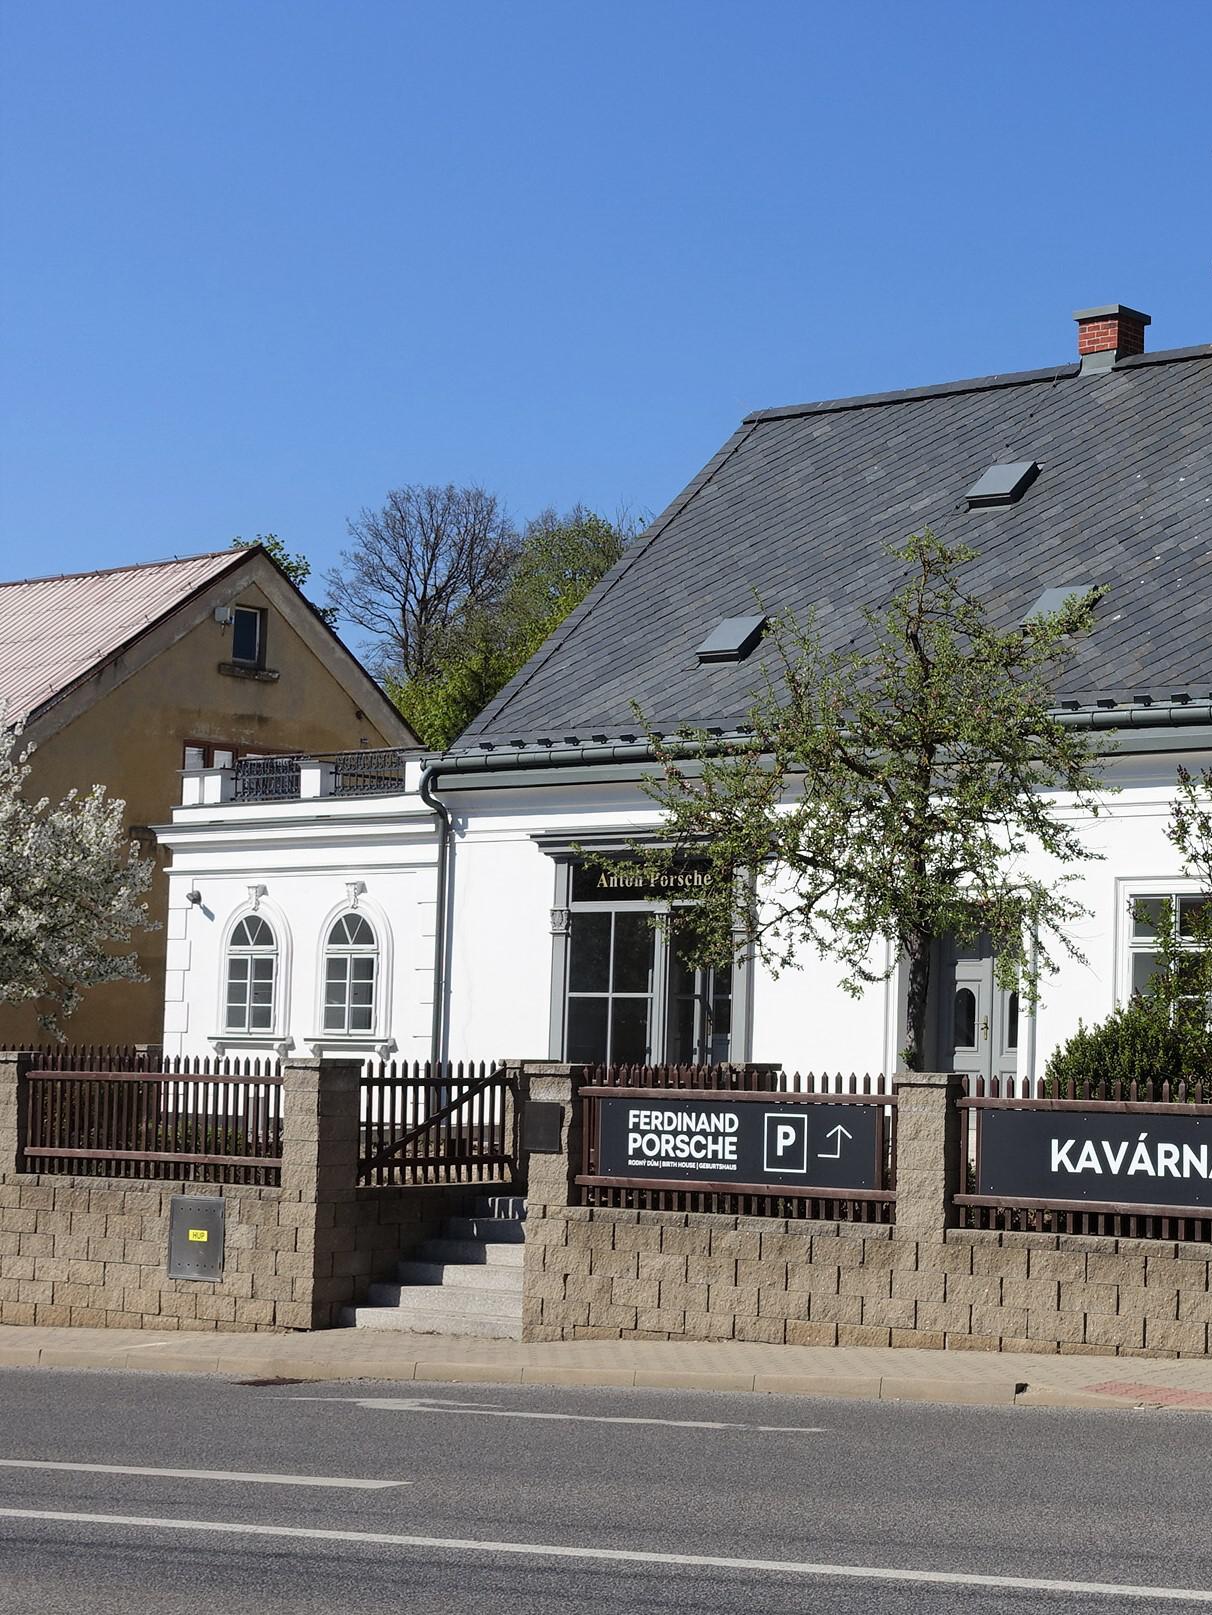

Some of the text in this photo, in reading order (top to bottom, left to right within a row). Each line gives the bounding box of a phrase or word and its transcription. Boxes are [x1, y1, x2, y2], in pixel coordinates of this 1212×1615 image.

[597, 870, 714, 888] Anton Porsche
[628, 1109, 739, 1133] FERDINAND
[628, 1132, 738, 1160] PORSCHE
[776, 1124, 796, 1156] P
[699, 1162, 737, 1171] GEBURTSHAUS
